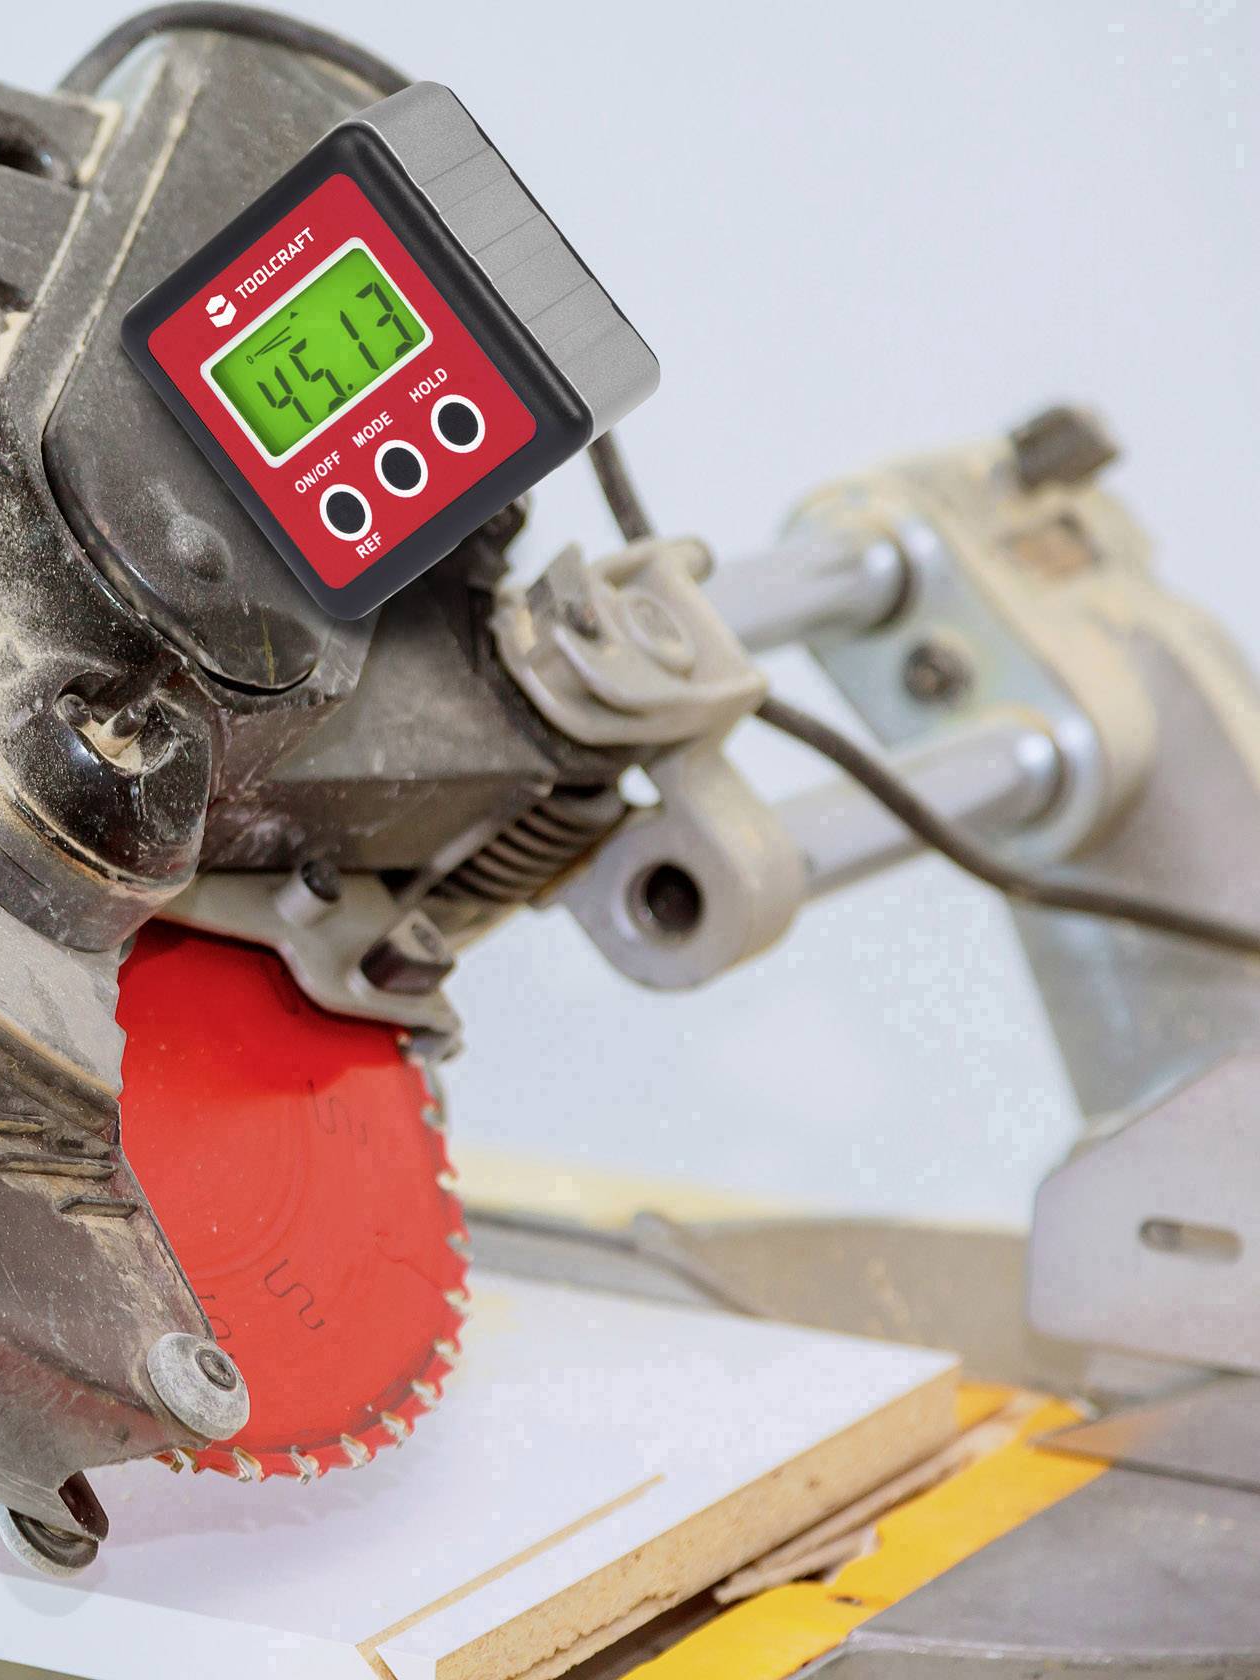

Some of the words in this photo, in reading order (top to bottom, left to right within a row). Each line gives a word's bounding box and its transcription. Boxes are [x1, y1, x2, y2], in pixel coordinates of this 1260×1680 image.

[234, 226, 315, 299] TOOLCRAFT
[256, 282, 413, 423] 45.13
[407, 366, 448, 403] HOLD
[351, 410, 394, 448] MODE
[293, 450, 342, 494] ON/OFF
[354, 531, 383, 559] REF
